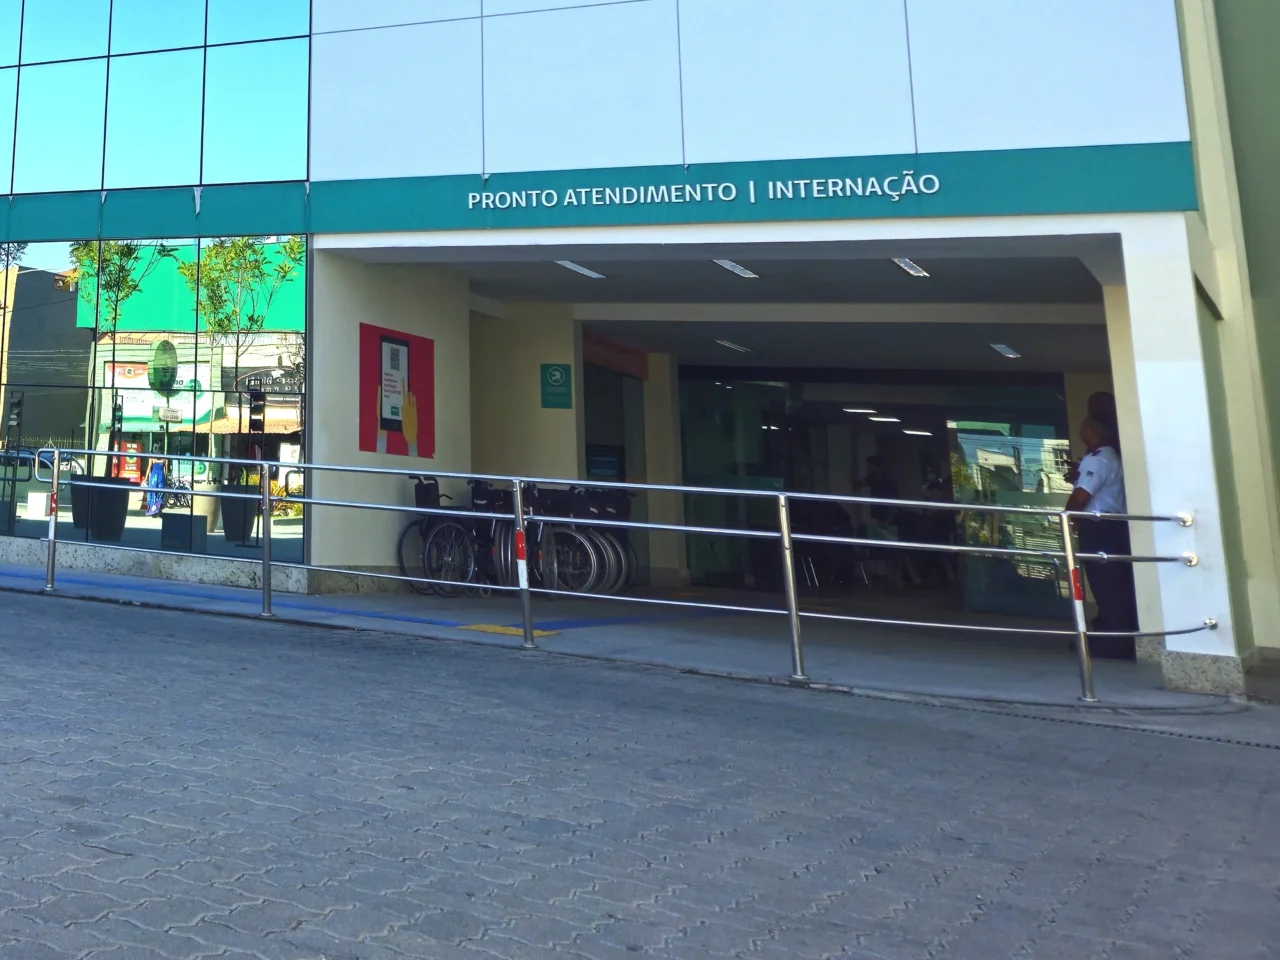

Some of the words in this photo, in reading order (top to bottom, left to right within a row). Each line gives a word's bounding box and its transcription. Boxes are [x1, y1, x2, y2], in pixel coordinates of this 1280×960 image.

[469, 189, 558, 209] PRONTO
[564, 182, 737, 207] ATENDIMENTO
[768, 170, 940, 202] INTERNAÇÃO
